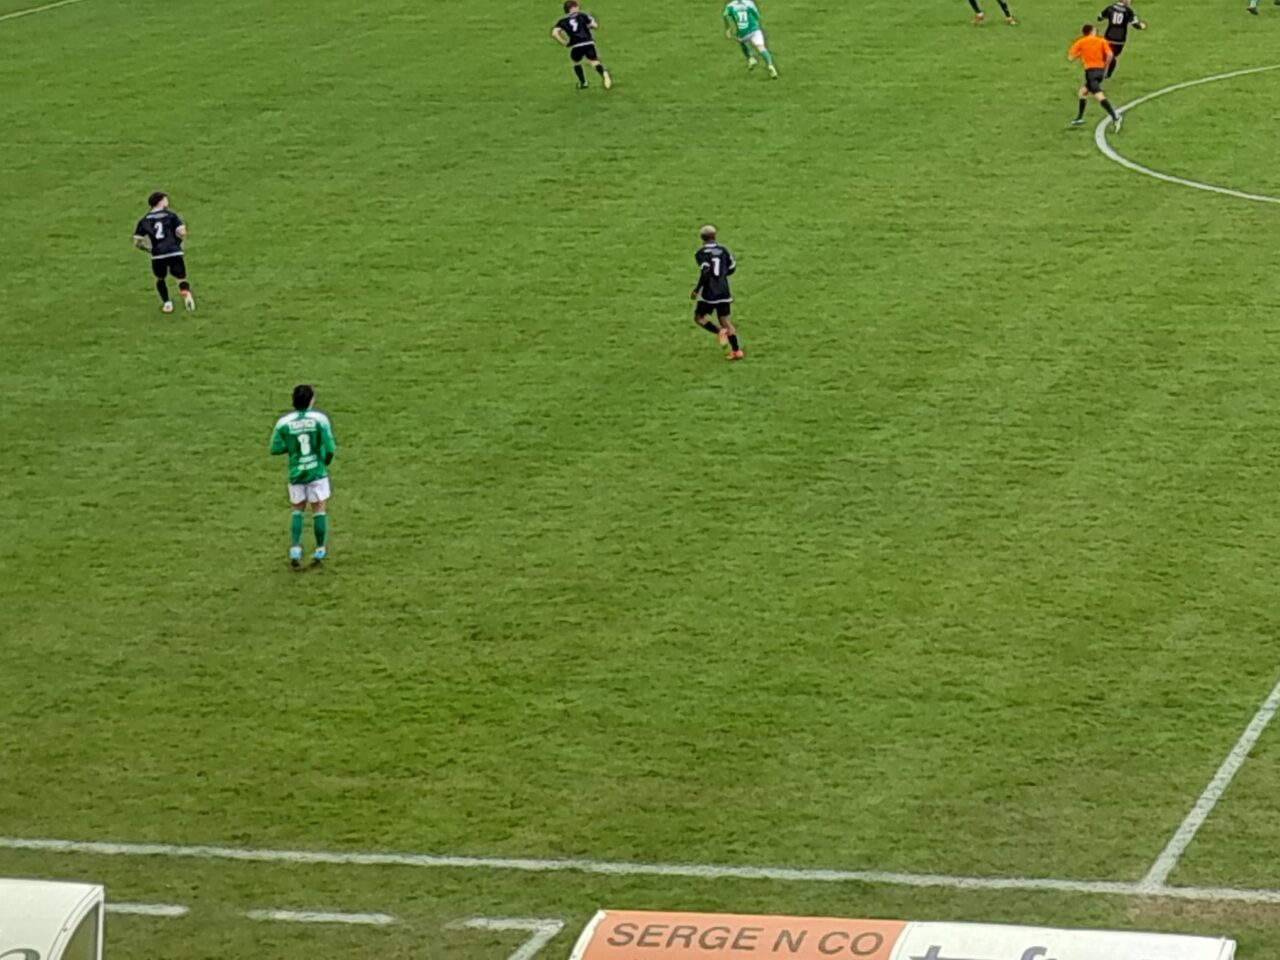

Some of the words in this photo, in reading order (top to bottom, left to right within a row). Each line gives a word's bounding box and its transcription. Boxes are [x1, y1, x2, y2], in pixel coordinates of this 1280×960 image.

[154, 222, 165, 239] 2
[606, 922, 764, 950] SERGE
[771, 929, 808, 953] N
[817, 931, 885, 957] CO
